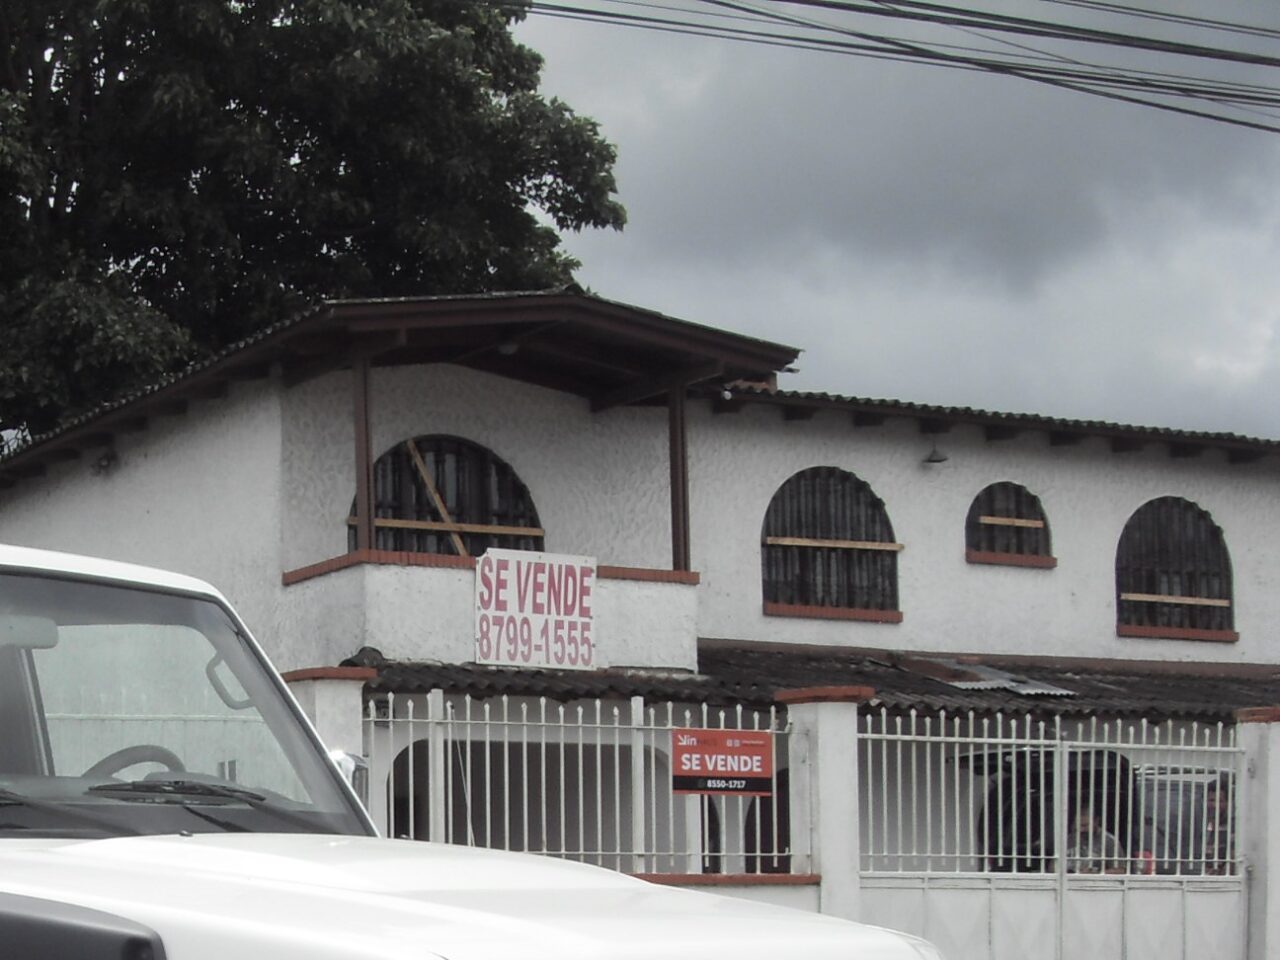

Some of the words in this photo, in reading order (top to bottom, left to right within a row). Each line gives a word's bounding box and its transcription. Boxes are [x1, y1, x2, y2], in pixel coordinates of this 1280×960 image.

[479, 556, 508, 611] SE
[516, 559, 593, 619] VENDE
[478, 615, 593, 666] 8799-1555
[681, 753, 701, 771] SE
[705, 754, 763, 773] VENDE
